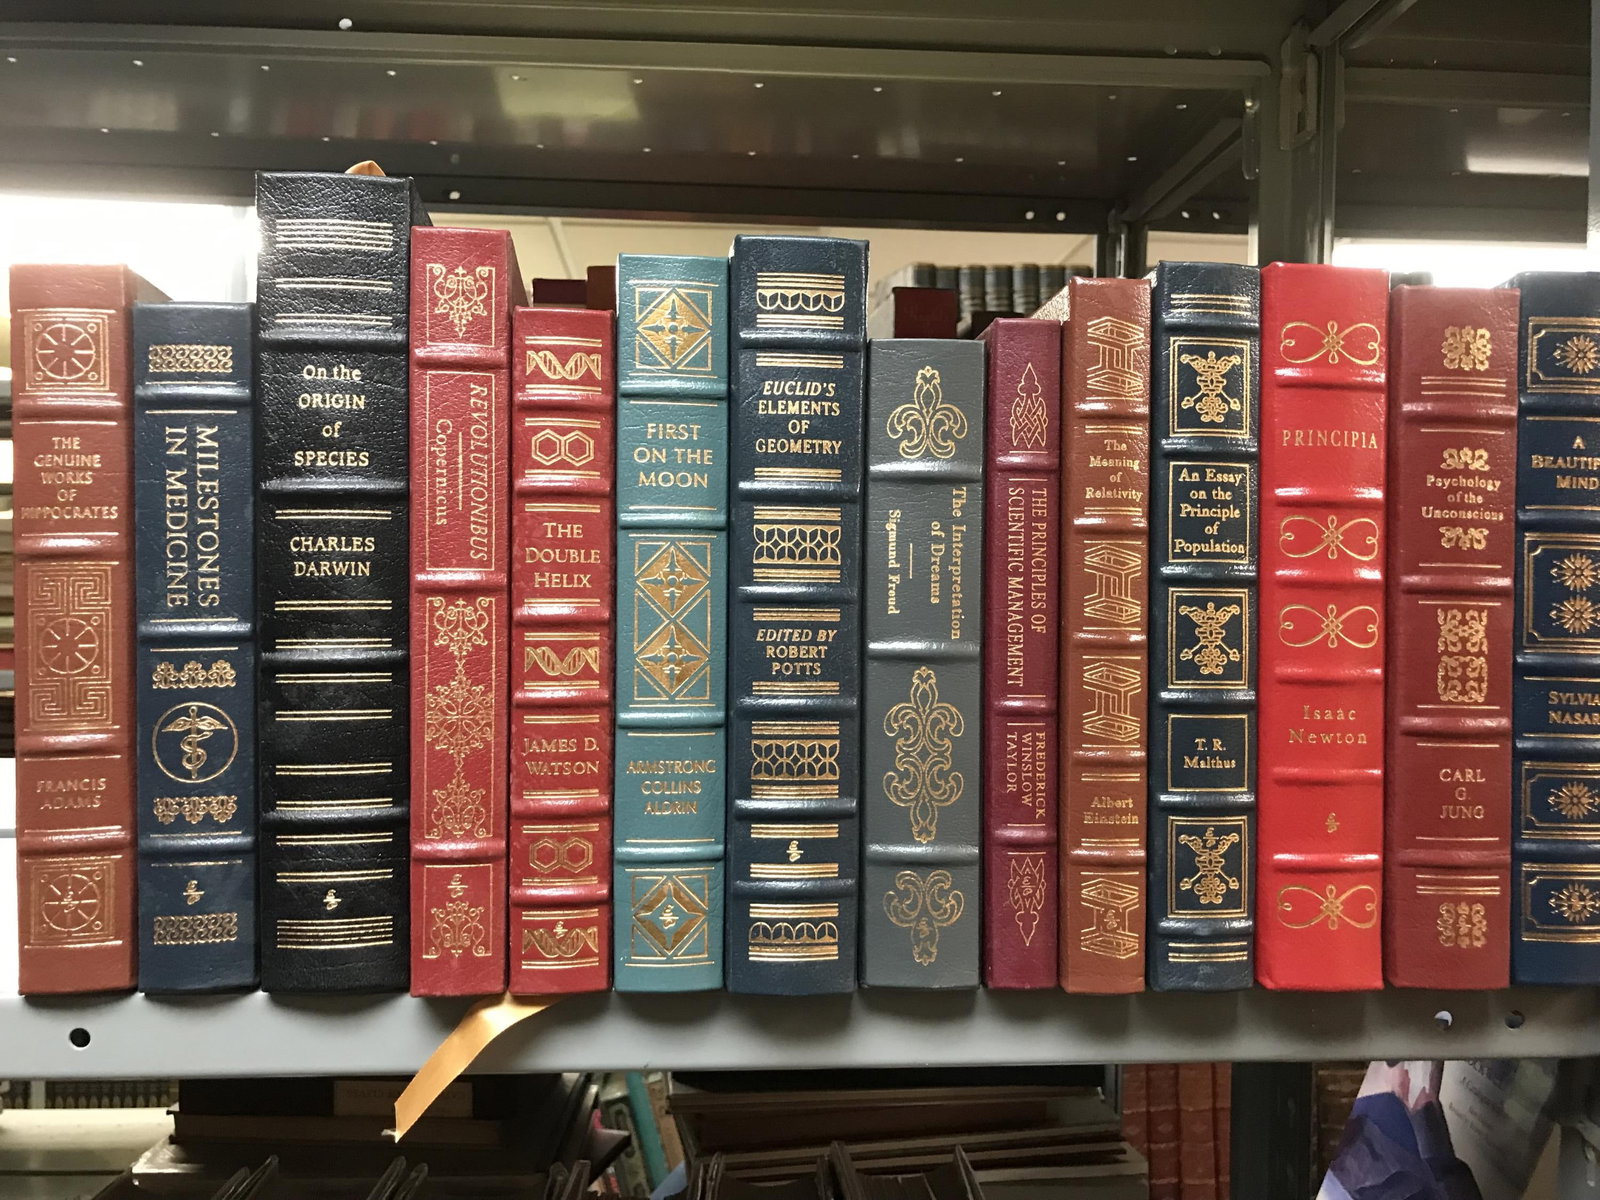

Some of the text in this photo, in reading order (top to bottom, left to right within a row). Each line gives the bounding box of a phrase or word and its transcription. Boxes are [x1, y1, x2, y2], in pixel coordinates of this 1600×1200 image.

[303, 365, 362, 380] On the
[762, 380, 836, 397] EUCLID'S
[298, 393, 366, 409] ORIGIN
[759, 400, 840, 416] ELEMENTS
[322, 422, 342, 438] of
[646, 423, 701, 441] FIRST
[788, 420, 810, 434] OF
[52, 437, 80, 450] THE
[1104, 440, 1127, 451] The
[1282, 430, 1378, 449] PRINCIPIA
[1572, 436, 1586, 450] A
[756, 439, 842, 456] GEOMETRY
[34, 454, 102, 467] GENUINE
[294, 451, 370, 466] SPECIES
[633, 448, 714, 465] ON THE
[1089, 456, 1140, 470] Meaning
[40, 472, 93, 484] WORKS
[430, 420, 452, 526] Copernicus
[470, 383, 488, 561] REVOLUTIONIBUS
[1110, 472, 1122, 482] of
[1179, 468, 1242, 487] An Essay
[639, 471, 708, 489] MOON
[1426, 474, 1502, 492] Psychology
[1556, 475, 1600, 490] MIND
[57, 489, 78, 502] OF
[1085, 487, 1144, 502] Relativity
[1190, 487, 1233, 501] on the
[1447, 491, 1484, 504] of the
[21, 506, 118, 520] HIPPOCRATES
[166, 426, 188, 608] IN MEDICINE
[196, 426, 220, 608] MILESTONES
[1180, 504, 1240, 521] Principle
[1421, 506, 1504, 520] Unconscious
[543, 522, 583, 538] THE
[1204, 522, 1220, 536] of
[290, 536, 376, 552] CHARLES
[1174, 539, 1245, 556] Population
[525, 547, 600, 564] DOUBLE
[886, 510, 902, 614] Sigmund Freud
[930, 520, 945, 604] of Dreams
[948, 486, 967, 640] The Interpretation
[1031, 488, 1048, 634] THE PRINCIPLES OF
[294, 562, 372, 576] DARWIN
[534, 572, 592, 588] HELIX
[1007, 488, 1025, 687] SCIENTIFIC MANAGEMENT
[756, 628, 838, 642] EDITED BY
[766, 646, 828, 659] ROBERT
[771, 662, 822, 676] POTTS
[1548, 691, 1600, 706] SYLVIA
[1303, 705, 1356, 720] Isaac
[1288, 728, 1368, 744] Newton
[521, 737, 600, 756] JAMES D.
[1194, 738, 1226, 752] T. R.
[525, 760, 600, 776] WATSON
[1006, 732, 1018, 794] TAYLOR
[1022, 732, 1032, 806] WINSLOW
[1184, 754, 1236, 770] Malthus
[1036, 732, 1046, 819] FREDERICK
[1440, 768, 1486, 782] CARL
[36, 778, 106, 792] FRANCIS
[641, 780, 702, 794] COLLINS
[40, 796, 101, 810] ADAMS
[644, 801, 698, 815] ALDRIN
[1090, 796, 1134, 808] Albert
[1083, 812, 1138, 824] Einstein
[1440, 805, 1484, 819] JUNG
